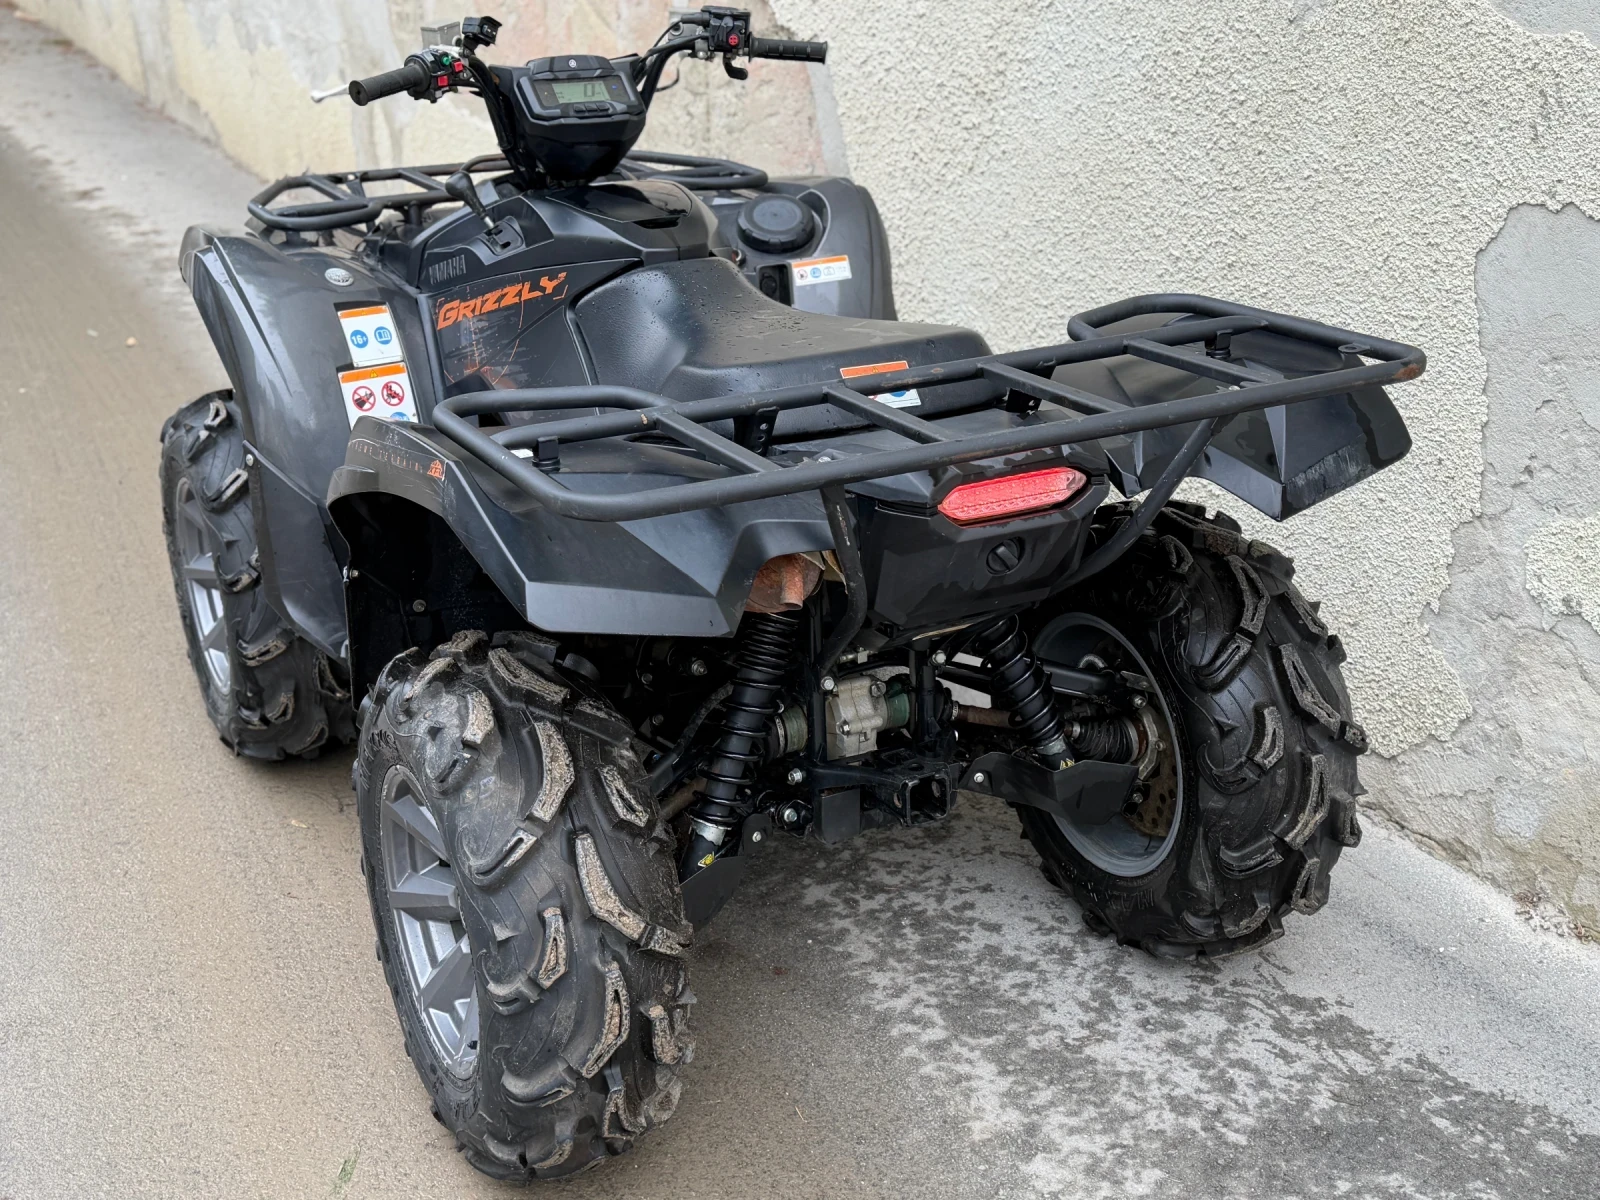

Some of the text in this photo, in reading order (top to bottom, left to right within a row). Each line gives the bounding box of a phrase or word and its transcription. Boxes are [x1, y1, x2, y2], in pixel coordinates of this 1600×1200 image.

[429, 254, 466, 285] YAMAHA
[437, 272, 567, 330] GRIZZLY
[352, 335, 367, 344] 16+
